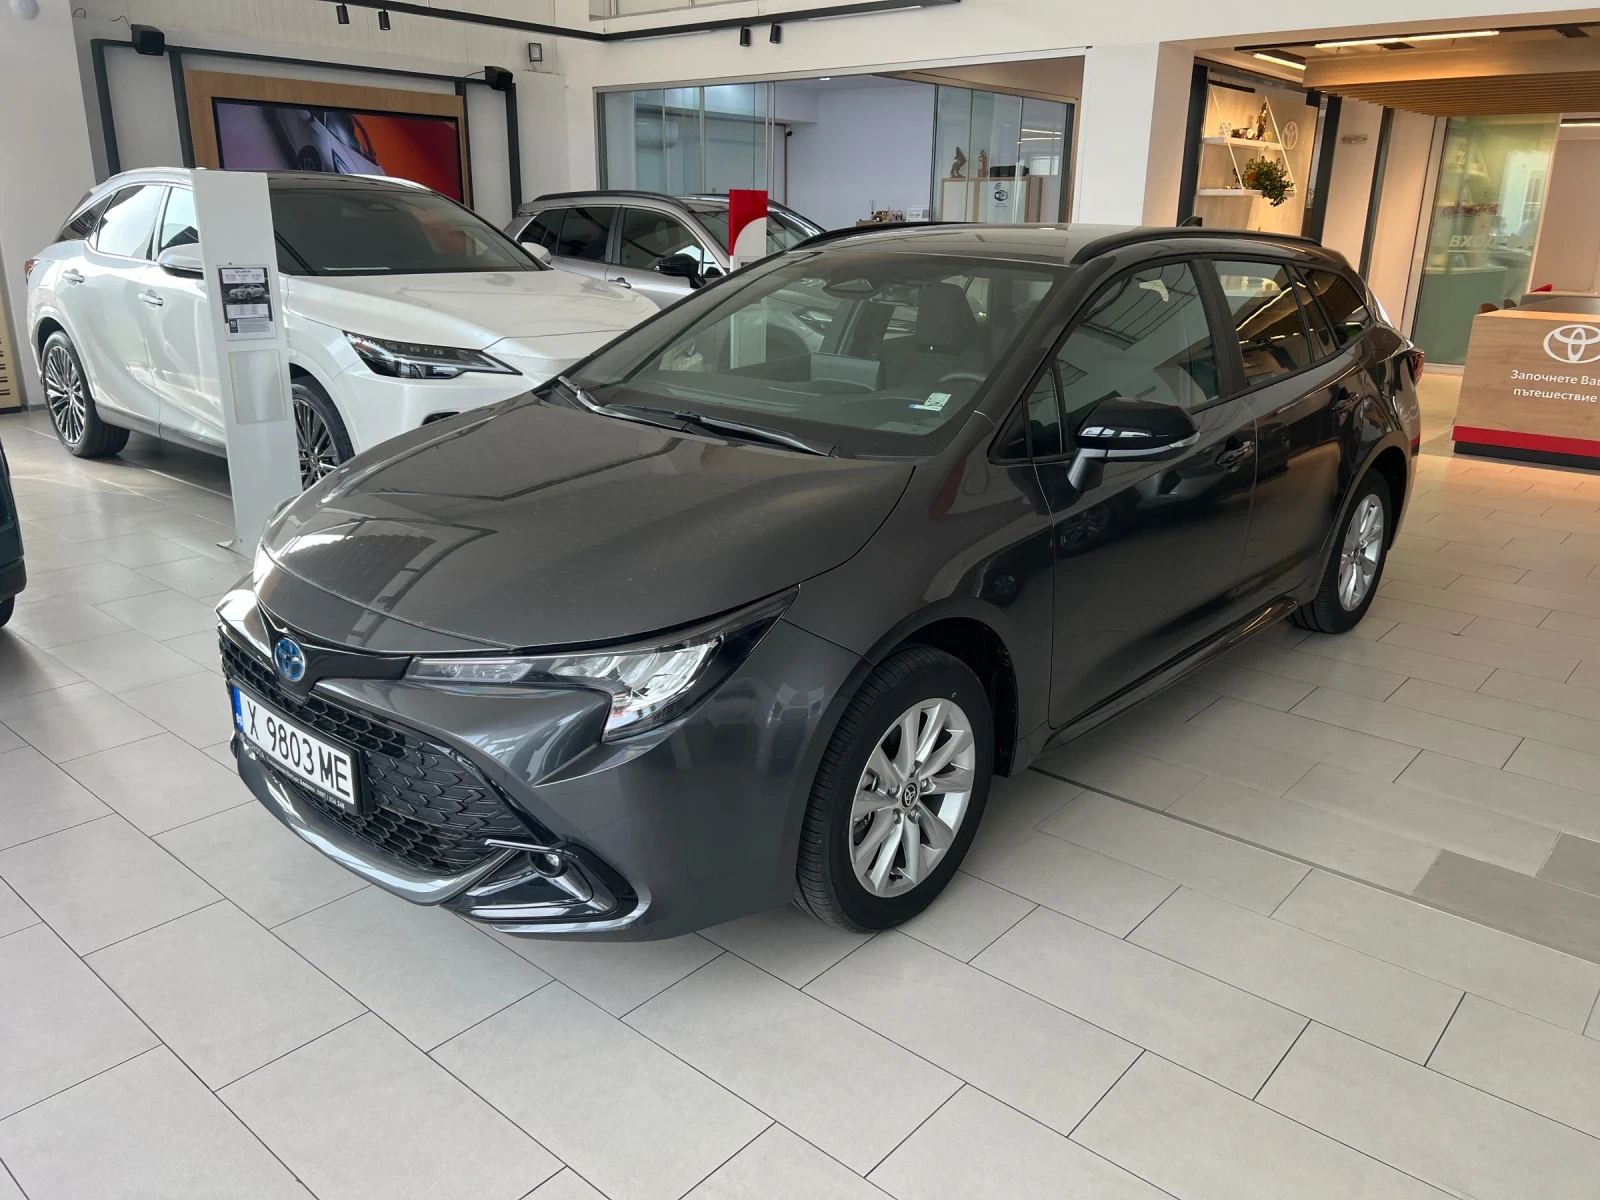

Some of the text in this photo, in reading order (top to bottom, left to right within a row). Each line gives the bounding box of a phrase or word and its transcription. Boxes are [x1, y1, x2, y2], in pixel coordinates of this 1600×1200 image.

[1510, 369, 1600, 387] Започнете Ва
[1513, 388, 1598, 403] пътешествие
[247, 700, 259, 741] X
[266, 716, 315, 776] 9803
[318, 745, 351, 798] ME
